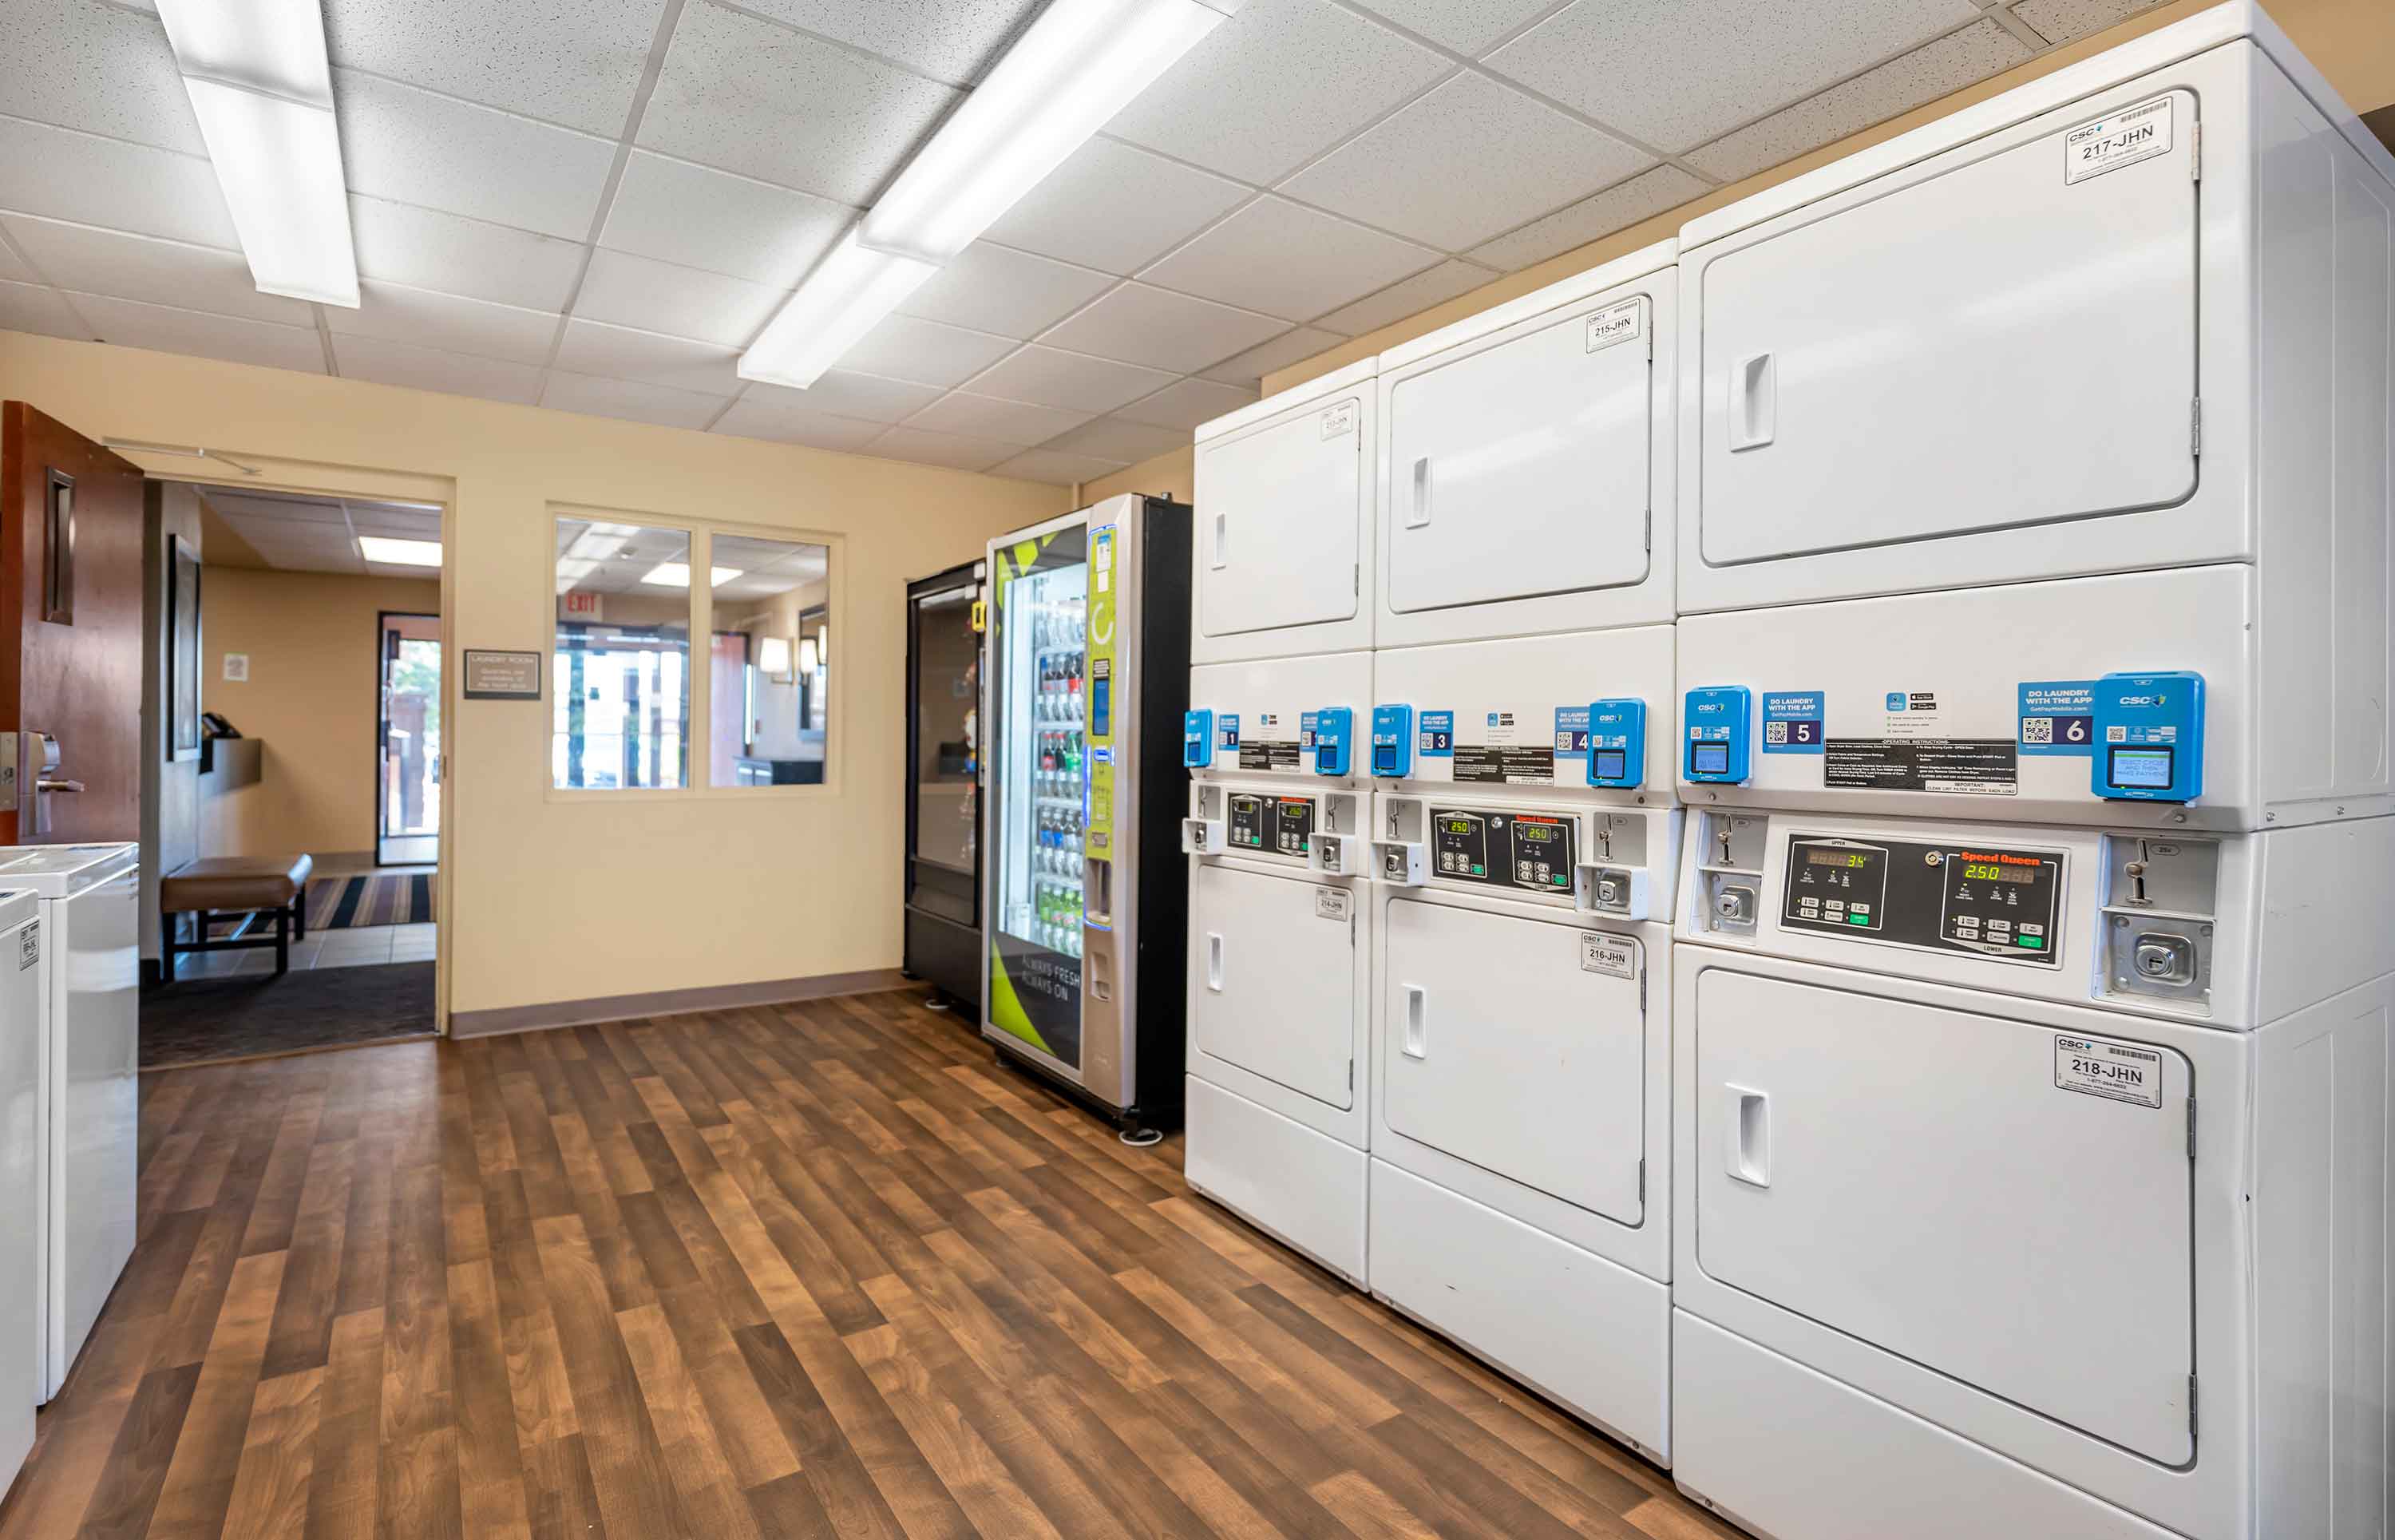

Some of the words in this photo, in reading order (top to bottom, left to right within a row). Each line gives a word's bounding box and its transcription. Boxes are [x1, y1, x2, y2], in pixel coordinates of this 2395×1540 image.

[2069, 128, 2095, 142] CSC
[2083, 125, 2153, 160] 217-JHN
[1595, 317, 1631, 337] 215-JHN
[568, 594, 595, 613] EXIT
[2120, 696, 2151, 705] CSC
[1230, 733, 1234, 744] 1
[1797, 724, 1811, 742] 5
[2067, 720, 2084, 742] 6
[1438, 734, 1445, 748] 3
[1578, 734, 1588, 749] 4
[1960, 851, 1999, 863] Speed
[2000, 853, 2041, 865] Queen
[1965, 865, 2000, 880] 2.50
[1589, 948, 1625, 963] 216-JHN
[1023, 952, 1052, 977] ALWAYS
[1054, 965, 1080, 988] FRESH
[1023, 971, 1052, 995] ALWAYS
[1054, 984, 1068, 1001] ON
[2059, 1039, 2084, 1049] CSC
[2072, 1059, 2142, 1083] 218-JHN
